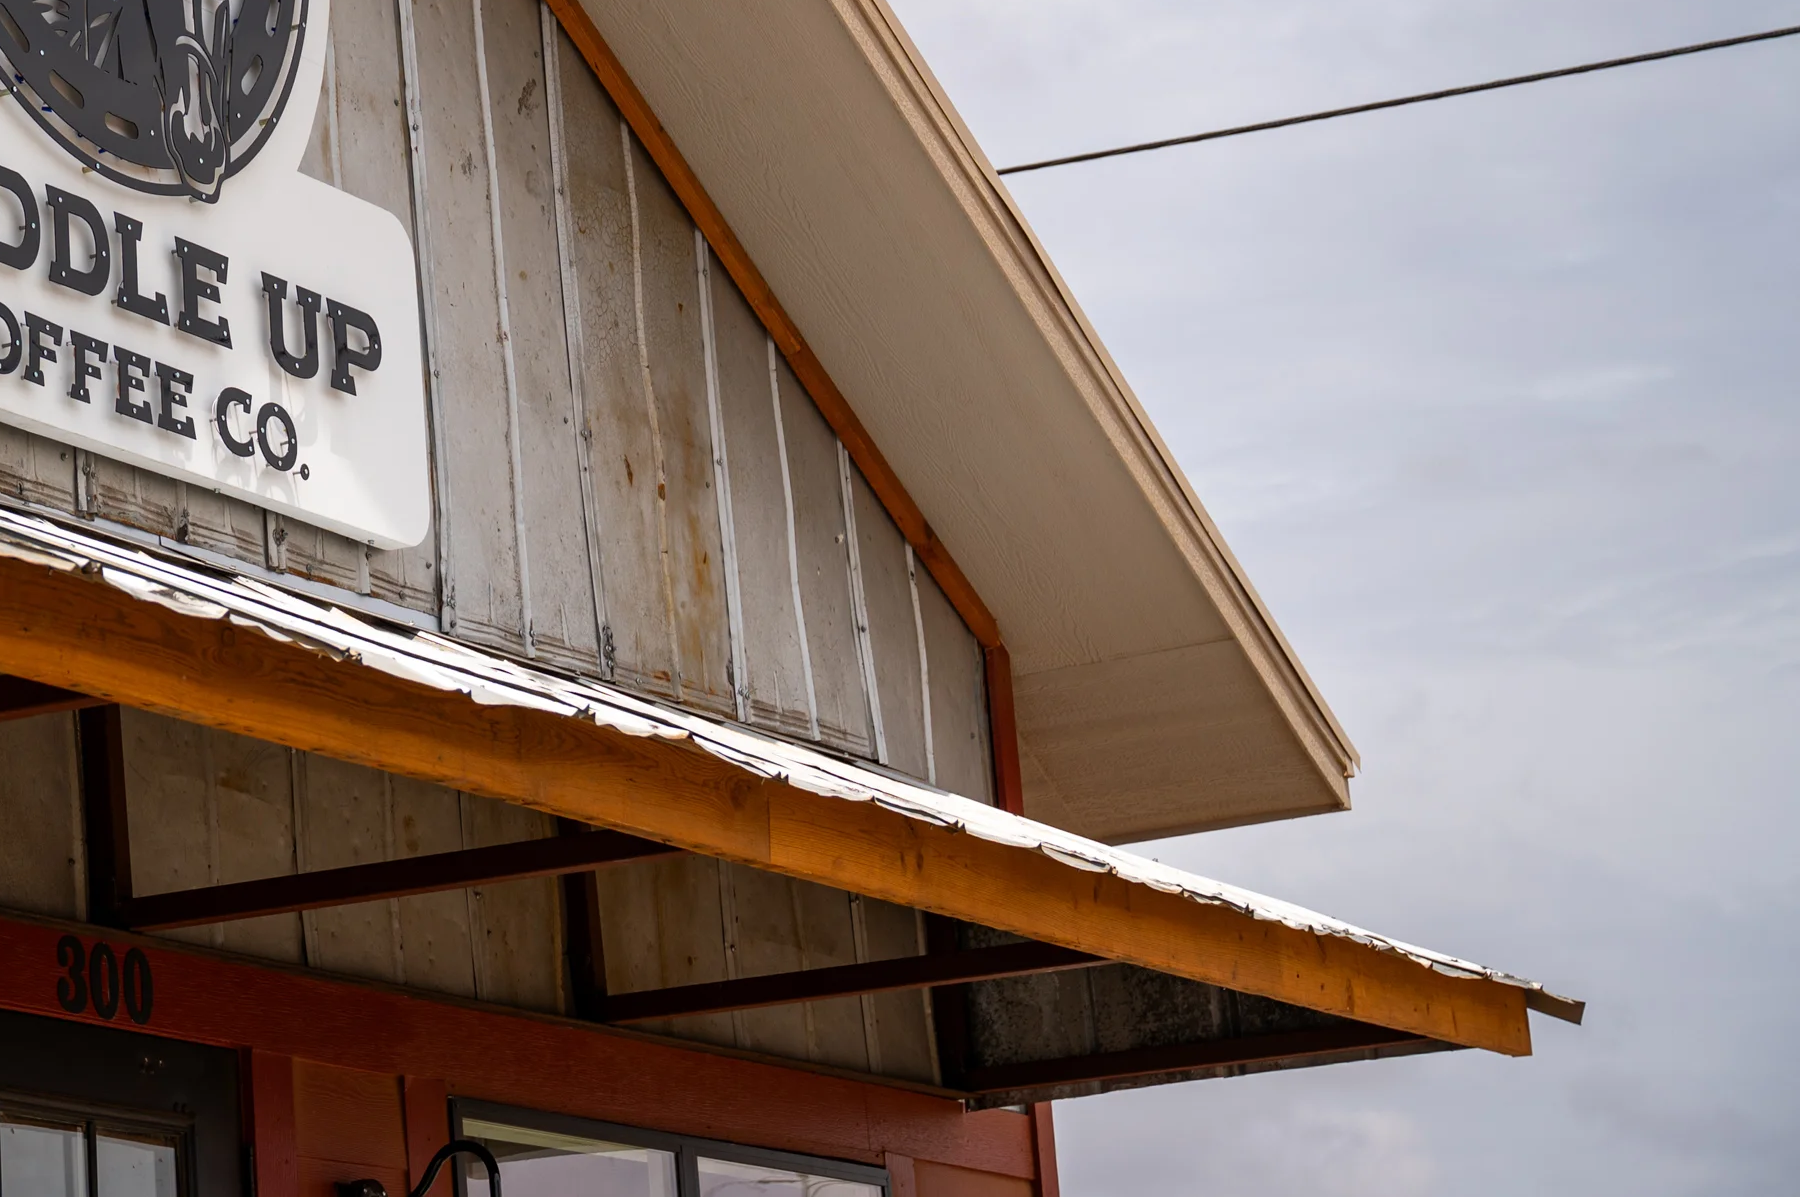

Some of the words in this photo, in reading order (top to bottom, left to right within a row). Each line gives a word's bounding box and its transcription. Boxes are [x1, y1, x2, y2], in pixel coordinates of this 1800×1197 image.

[259, 270, 383, 396] UP
[212, 386, 310, 481] CO.
[57, 934, 154, 1025] 300
